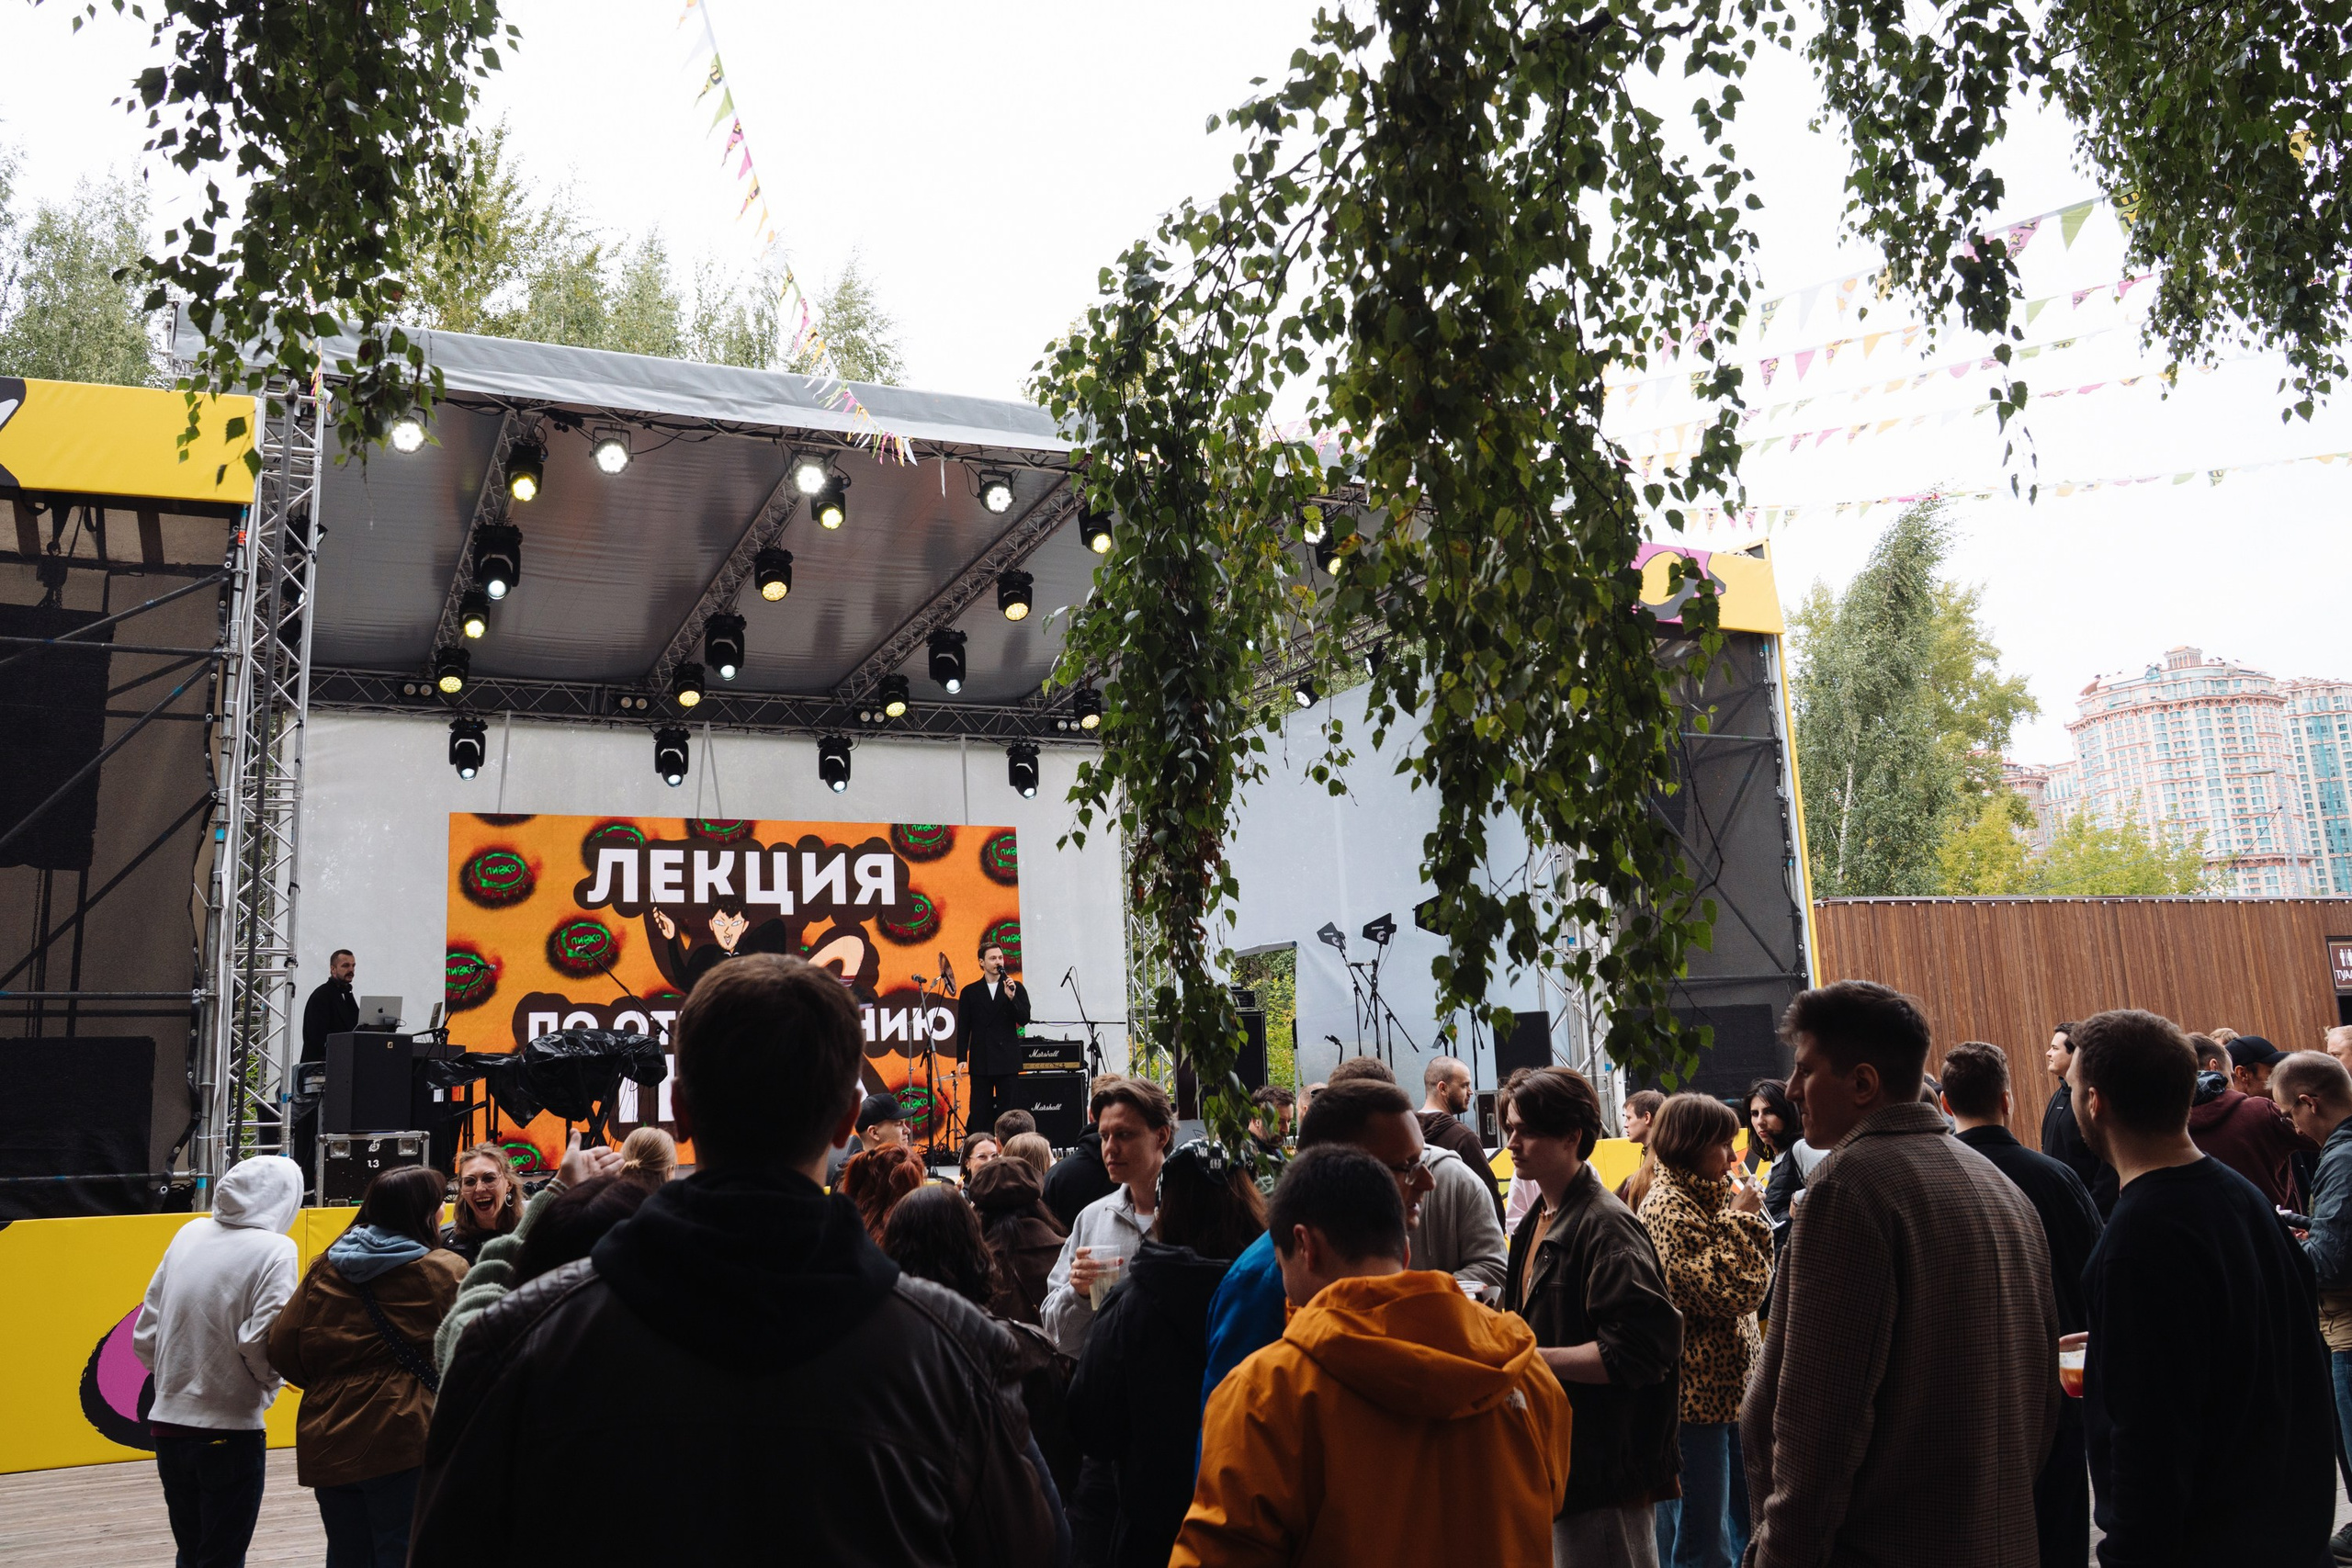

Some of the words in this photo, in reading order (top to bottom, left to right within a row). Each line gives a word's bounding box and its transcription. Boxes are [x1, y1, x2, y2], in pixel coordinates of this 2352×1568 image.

[587, 848, 897, 916] ЛЕКЦИЯ
[1029, 1049, 1059, 1058] Marshall
[1031, 1102, 1062, 1111] Marshall
